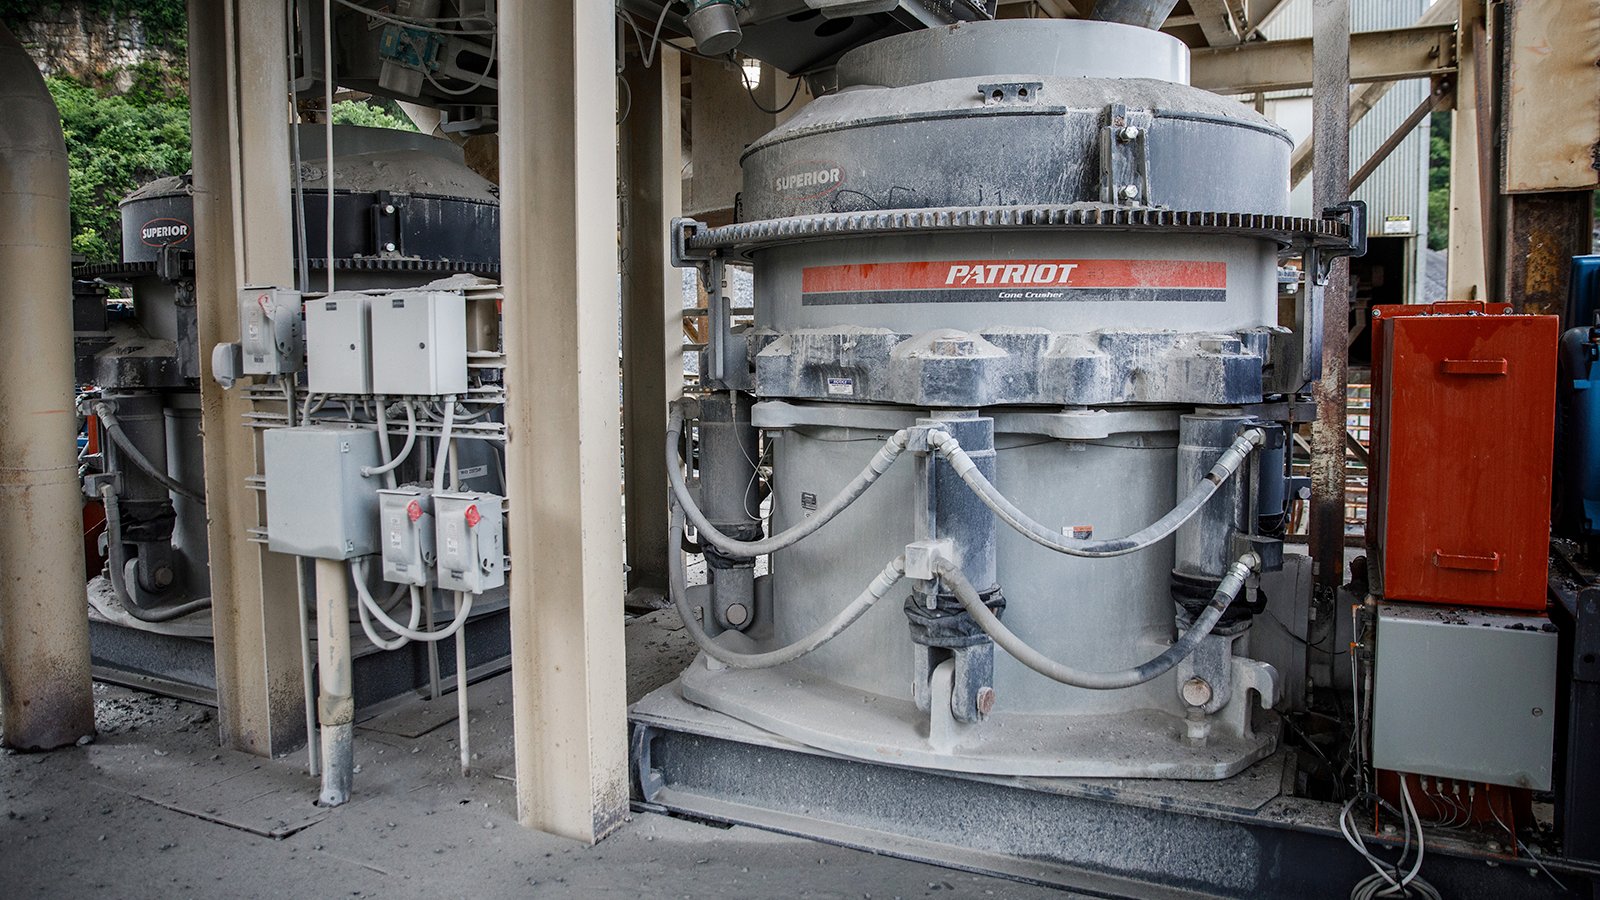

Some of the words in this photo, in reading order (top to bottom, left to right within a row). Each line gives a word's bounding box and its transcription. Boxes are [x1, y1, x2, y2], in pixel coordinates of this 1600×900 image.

[776, 168, 840, 192] SUPERIOR
[142, 225, 188, 239] SUPERIOR
[945, 263, 1078, 284] PATRIOT
[998, 291, 1023, 299] Cone
[1025, 291, 1063, 299] Crusher
